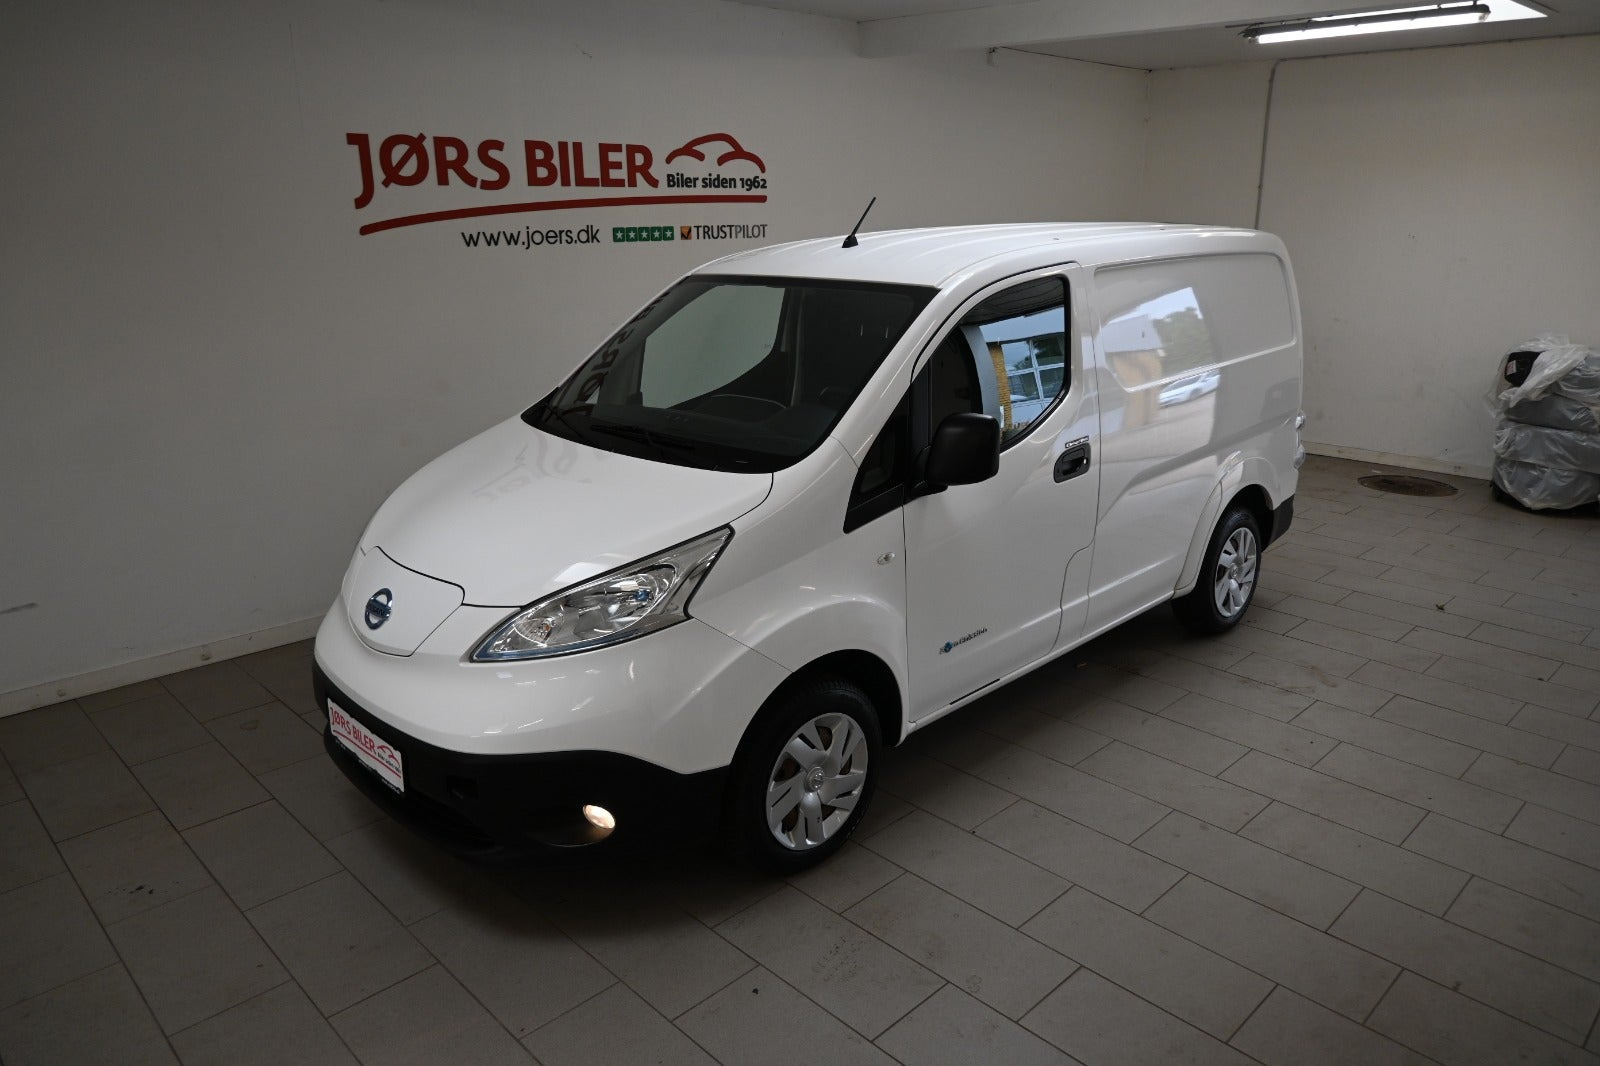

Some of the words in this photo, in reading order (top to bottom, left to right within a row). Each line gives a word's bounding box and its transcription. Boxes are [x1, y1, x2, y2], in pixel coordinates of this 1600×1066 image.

[346, 133, 510, 209] JØRS
[524, 139, 659, 188] BILER
[666, 172, 699, 188] Biler
[701, 173, 737, 189] siden
[740, 176, 768, 192] 1962
[461, 225, 600, 250] www.joers.dk
[694, 224, 768, 240] TRUSTPILOT
[330, 707, 351, 735] JØRS
[352, 725, 377, 755] BILER
